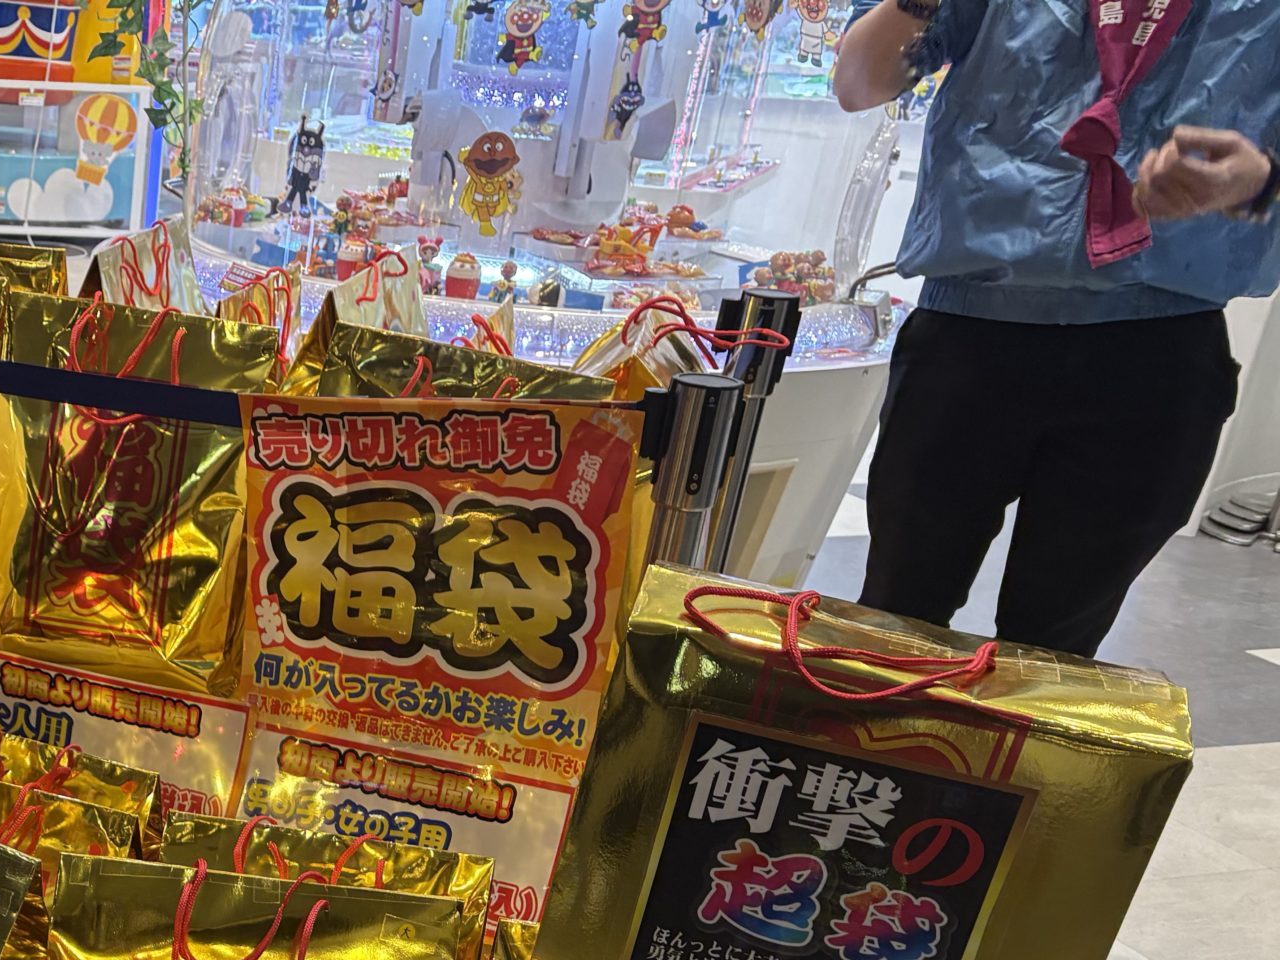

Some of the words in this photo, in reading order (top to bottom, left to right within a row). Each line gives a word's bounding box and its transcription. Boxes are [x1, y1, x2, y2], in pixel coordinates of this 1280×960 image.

[253, 409, 560, 472] 売り切れ御免
[566, 450, 604, 510] 福袋
[280, 494, 577, 669] 福袋
[688, 737, 985, 887] 衝撃の
